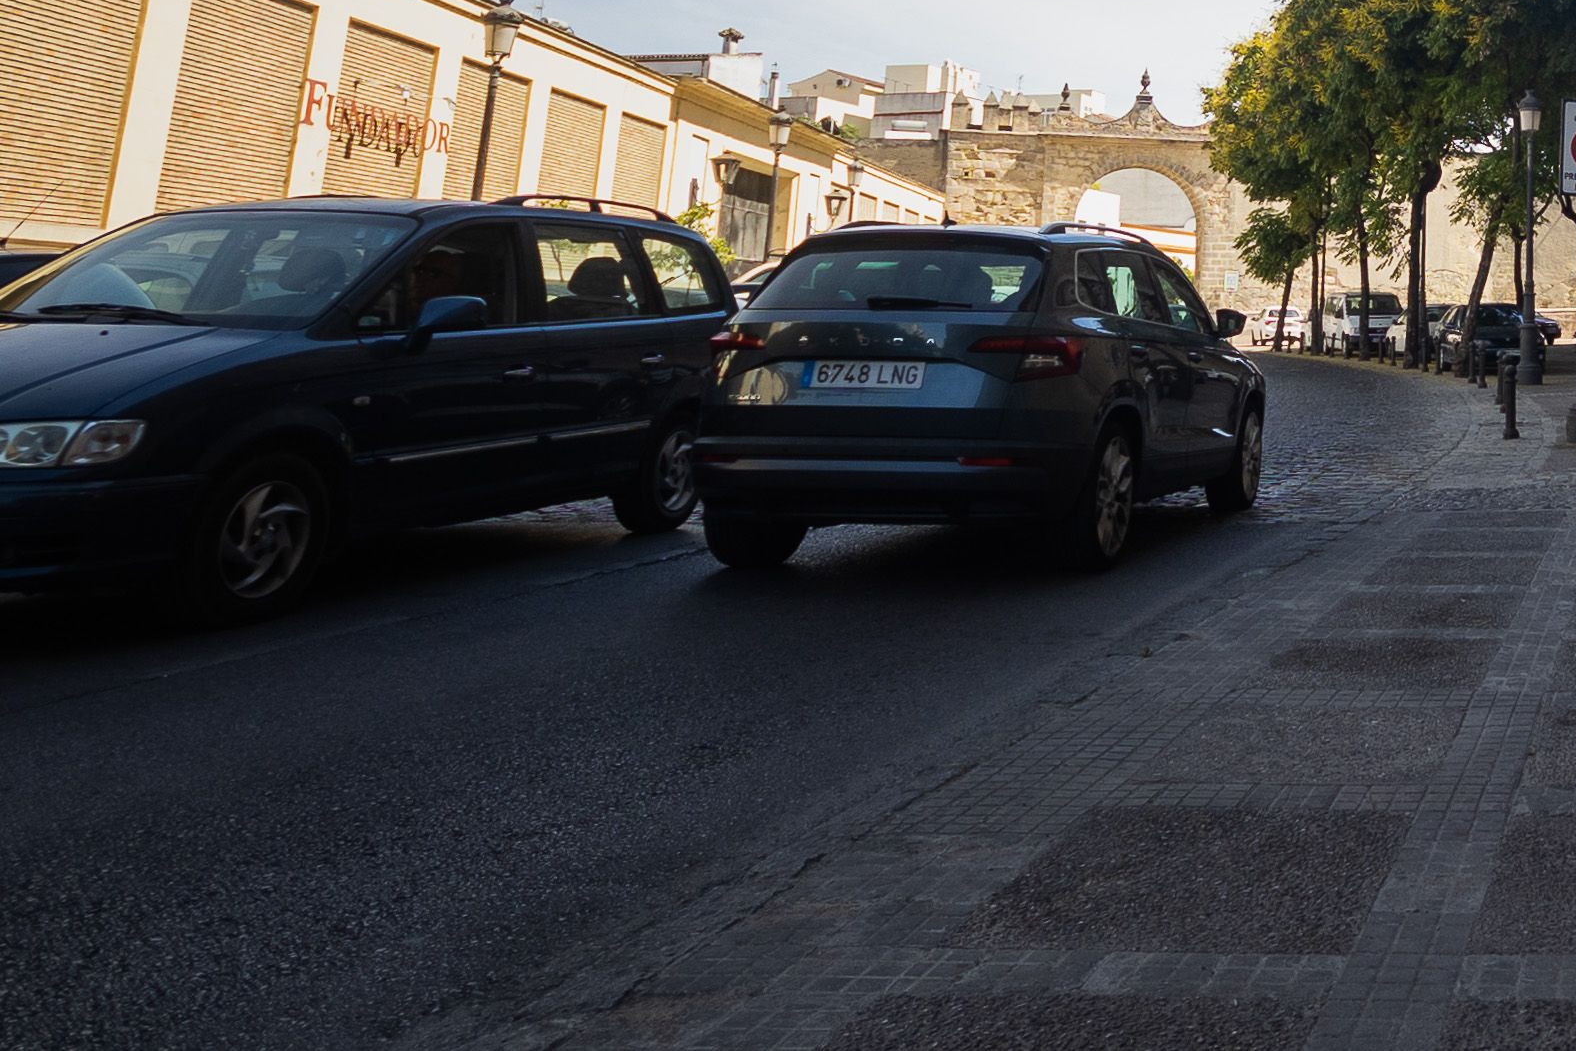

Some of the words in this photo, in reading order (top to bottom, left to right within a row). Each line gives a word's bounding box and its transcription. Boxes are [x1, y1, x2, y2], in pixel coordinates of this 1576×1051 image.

[301, 78, 450, 154] FUNDADOR
[817, 364, 871, 383] 6748
[876, 365, 918, 384] LNG
